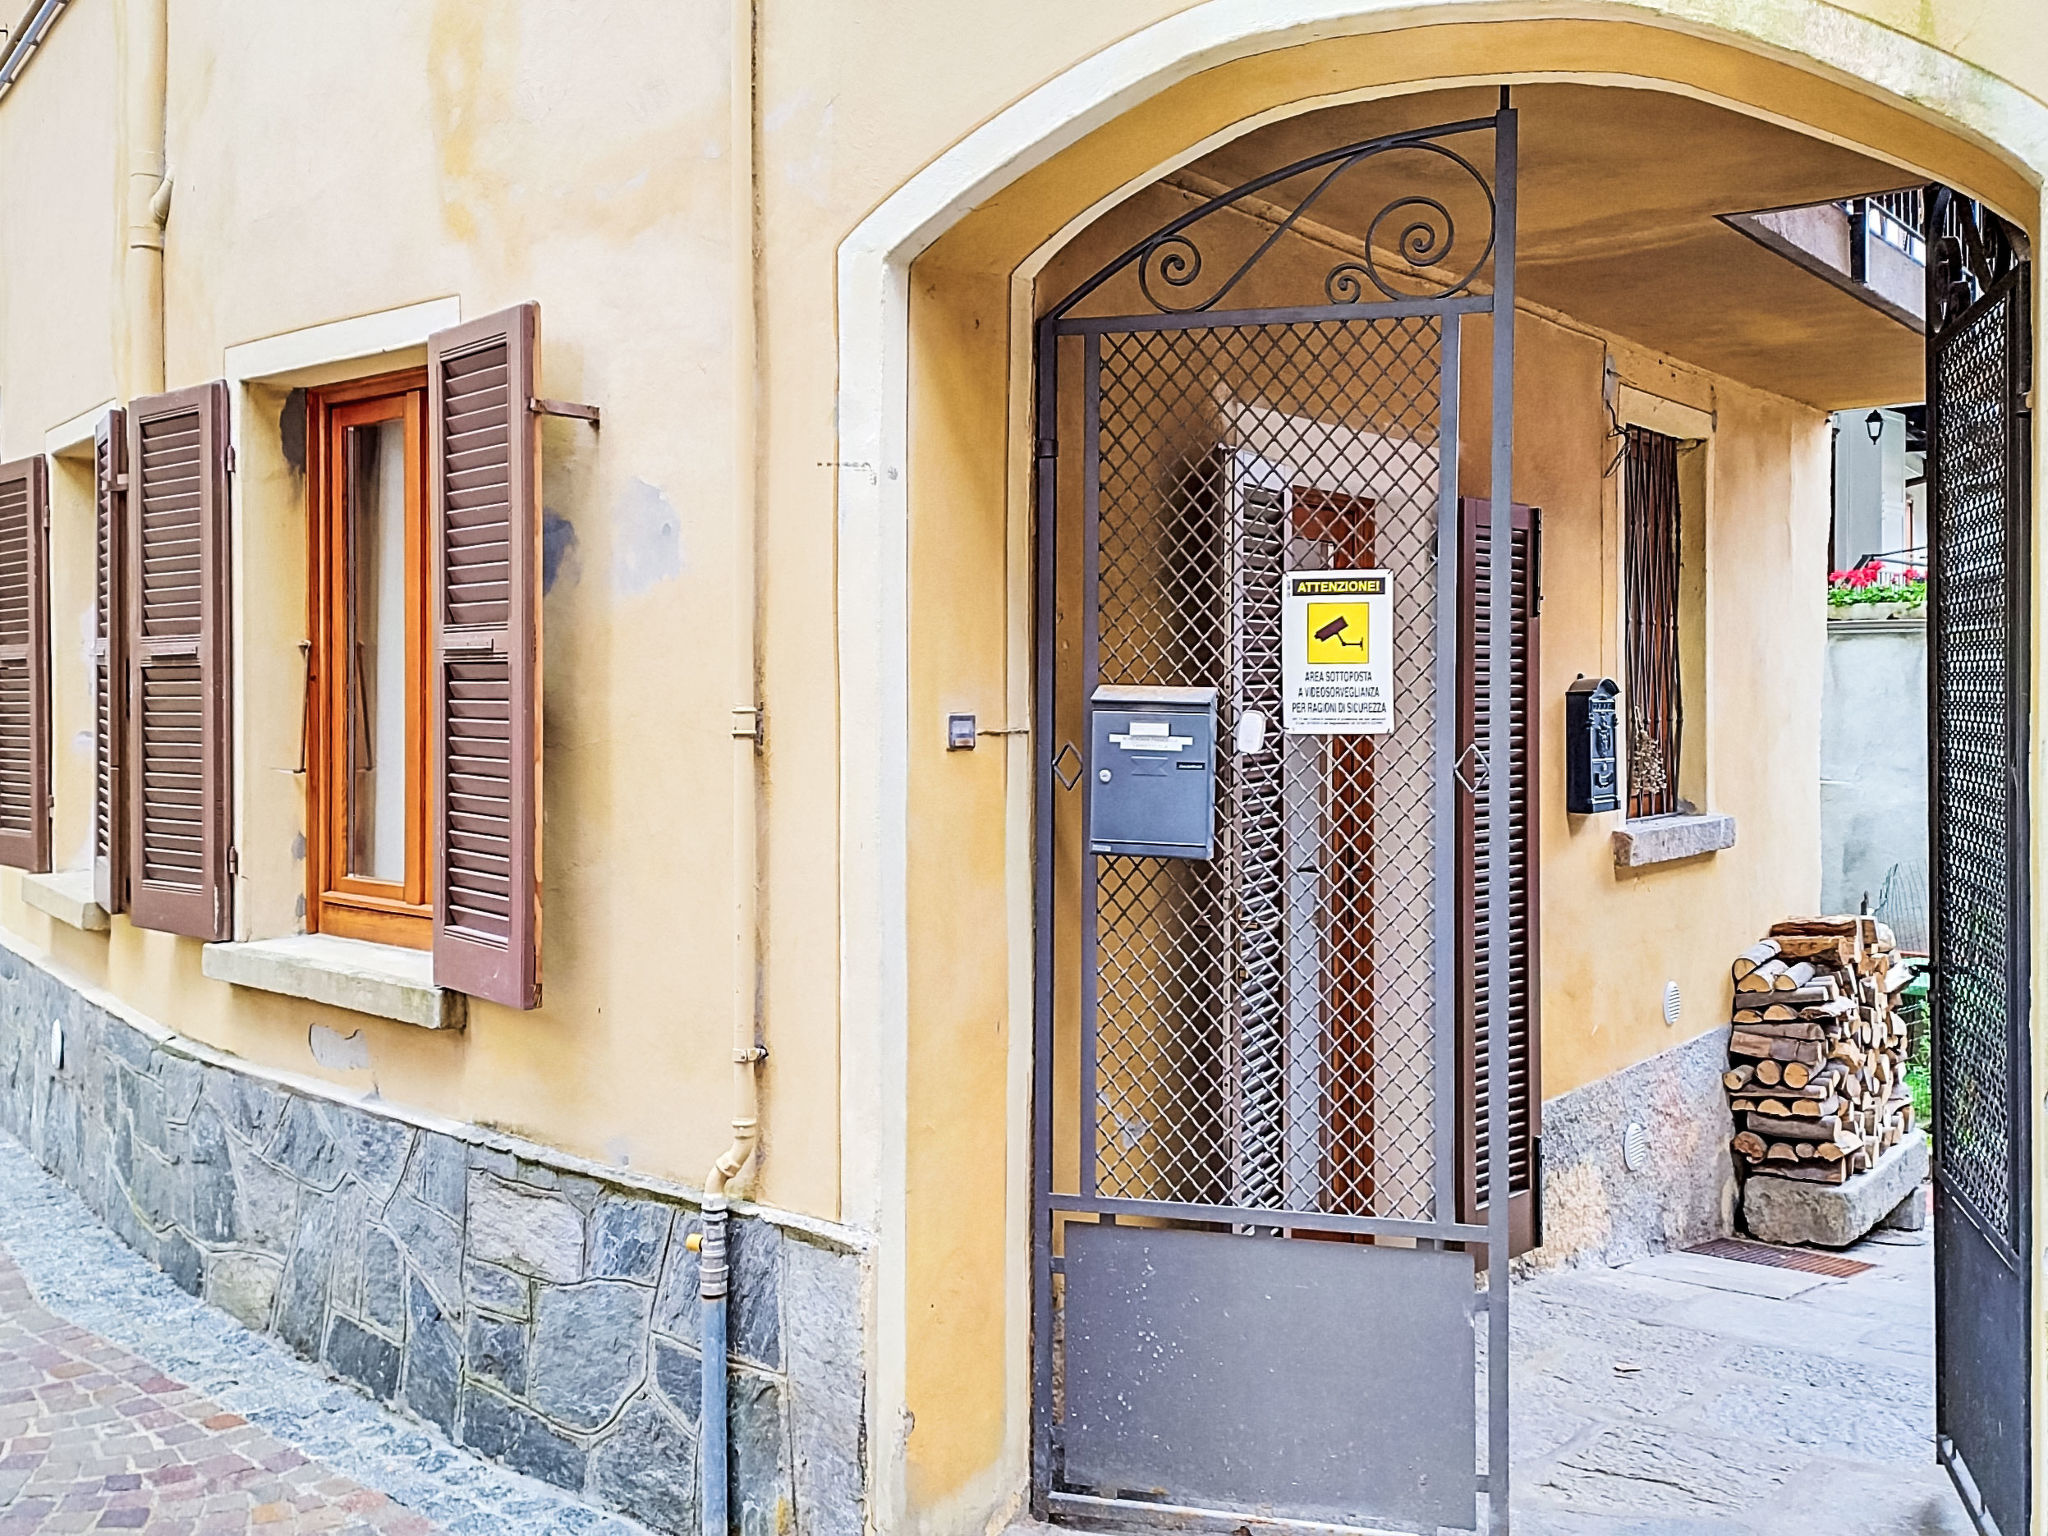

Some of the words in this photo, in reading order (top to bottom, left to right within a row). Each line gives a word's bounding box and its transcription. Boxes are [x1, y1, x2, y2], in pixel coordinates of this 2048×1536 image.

[1296, 580, 1380, 593] ATTENZIONE!
[1304, 671, 1324, 682] AREA
[1325, 671, 1372, 682] SOTTOPOSTA
[1297, 687, 1304, 698] A
[1305, 687, 1380, 698] VIDEOSORVEGLIANZA
[1291, 702, 1306, 713] PER
[1307, 702, 1337, 713] RAGIONI
[1338, 702, 1346, 713] DI
[1346, 702, 1387, 713] SICUREZZA
